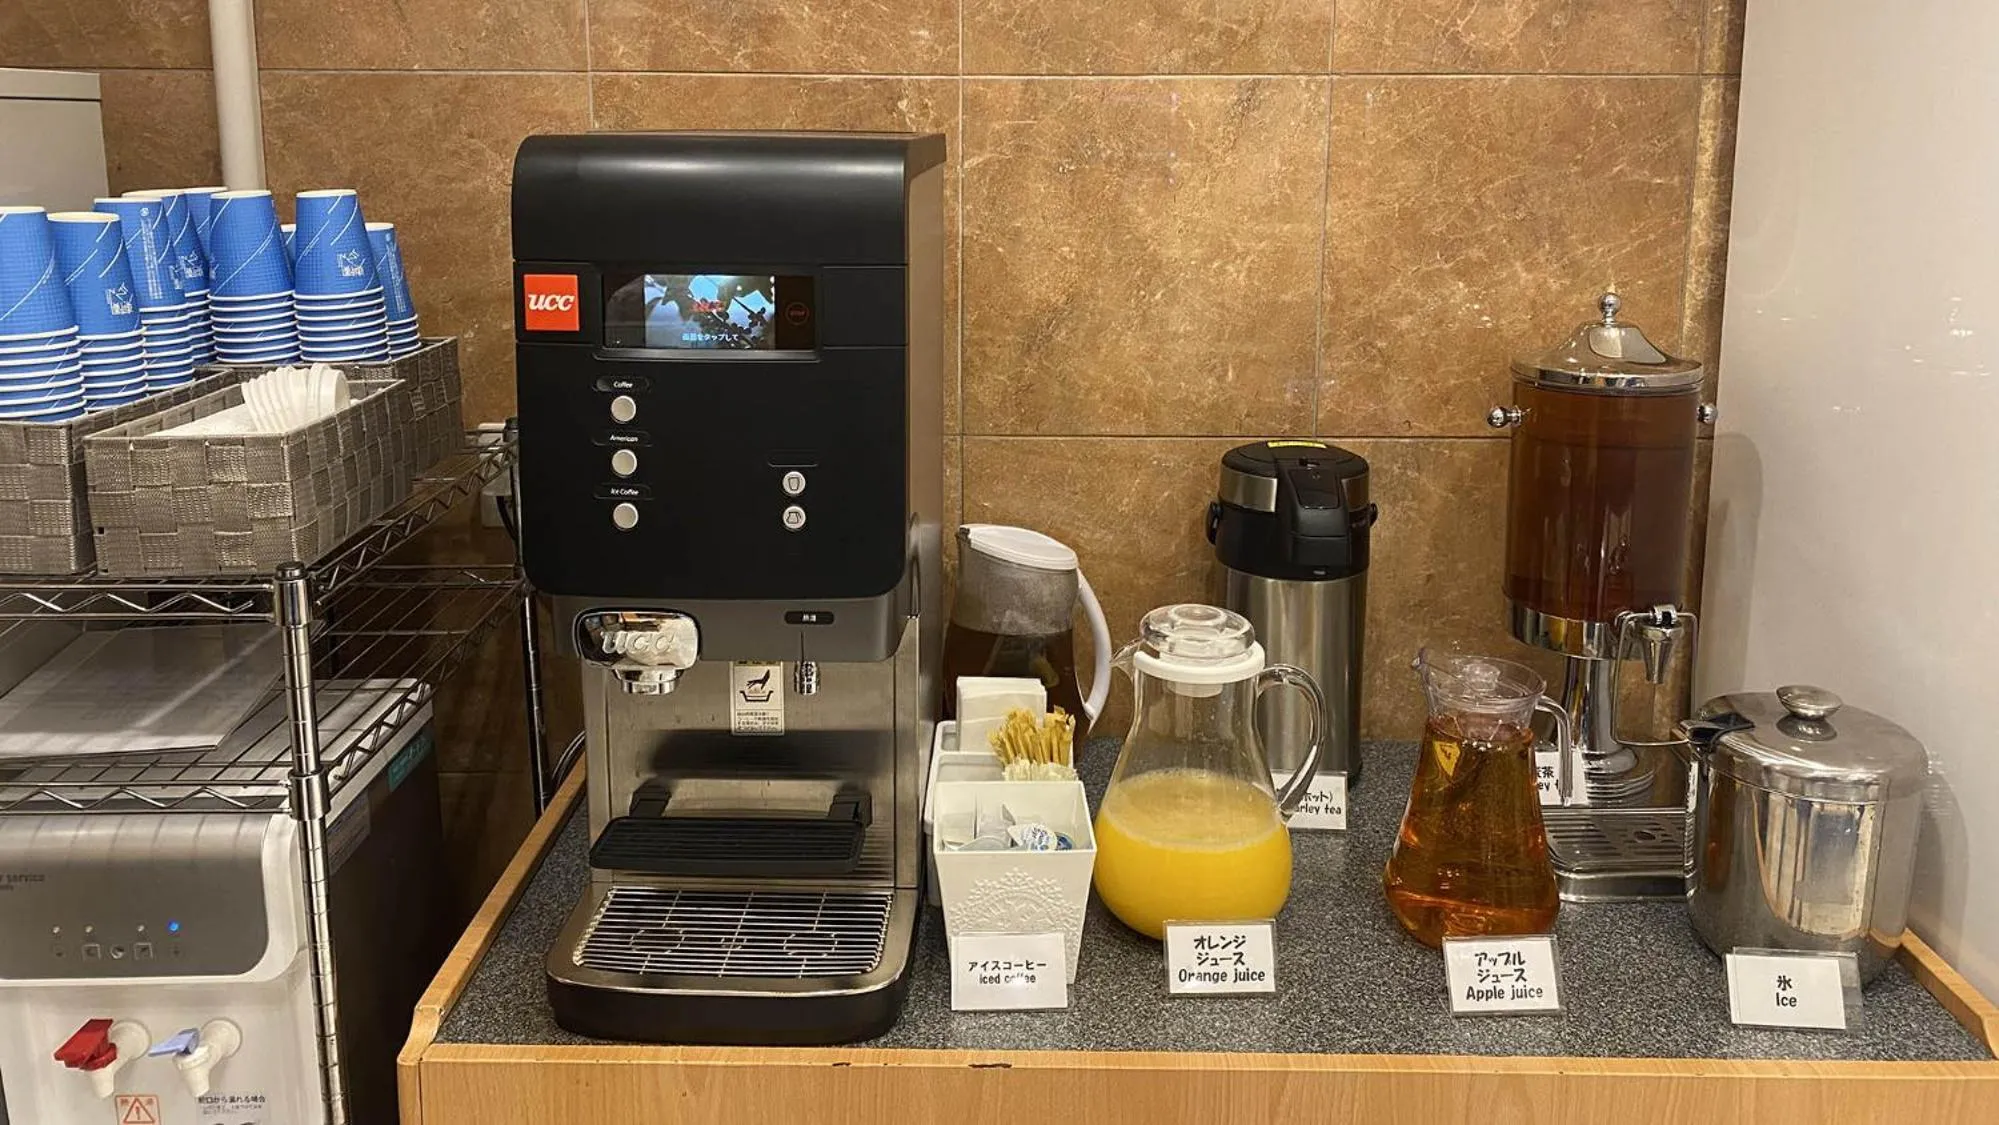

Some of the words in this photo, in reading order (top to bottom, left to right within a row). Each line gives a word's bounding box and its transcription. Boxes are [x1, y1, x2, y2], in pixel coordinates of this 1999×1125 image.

[613, 380, 633, 389] Coffee
[609, 433, 639, 443] American
[610, 487, 619, 496] Ice
[620, 488, 639, 497] Coffee
[1325, 804, 1342, 814] tea
[1193, 934, 1247, 950] オレンジ
[968, 960, 1047, 972] アイスコーヒー
[1196, 951, 1246, 967] ジュース
[1473, 951, 1526, 967] アップル
[979, 973, 1001, 985] iced
[1178, 968, 1228, 984] Orange
[1232, 968, 1266, 983] juice
[1477, 968, 1527, 984] ジュース
[1776, 975, 1792, 990] 氷
[1466, 985, 1506, 1002] Apple
[1511, 984, 1544, 1001] juice
[1776, 991, 1797, 1007] Ice
